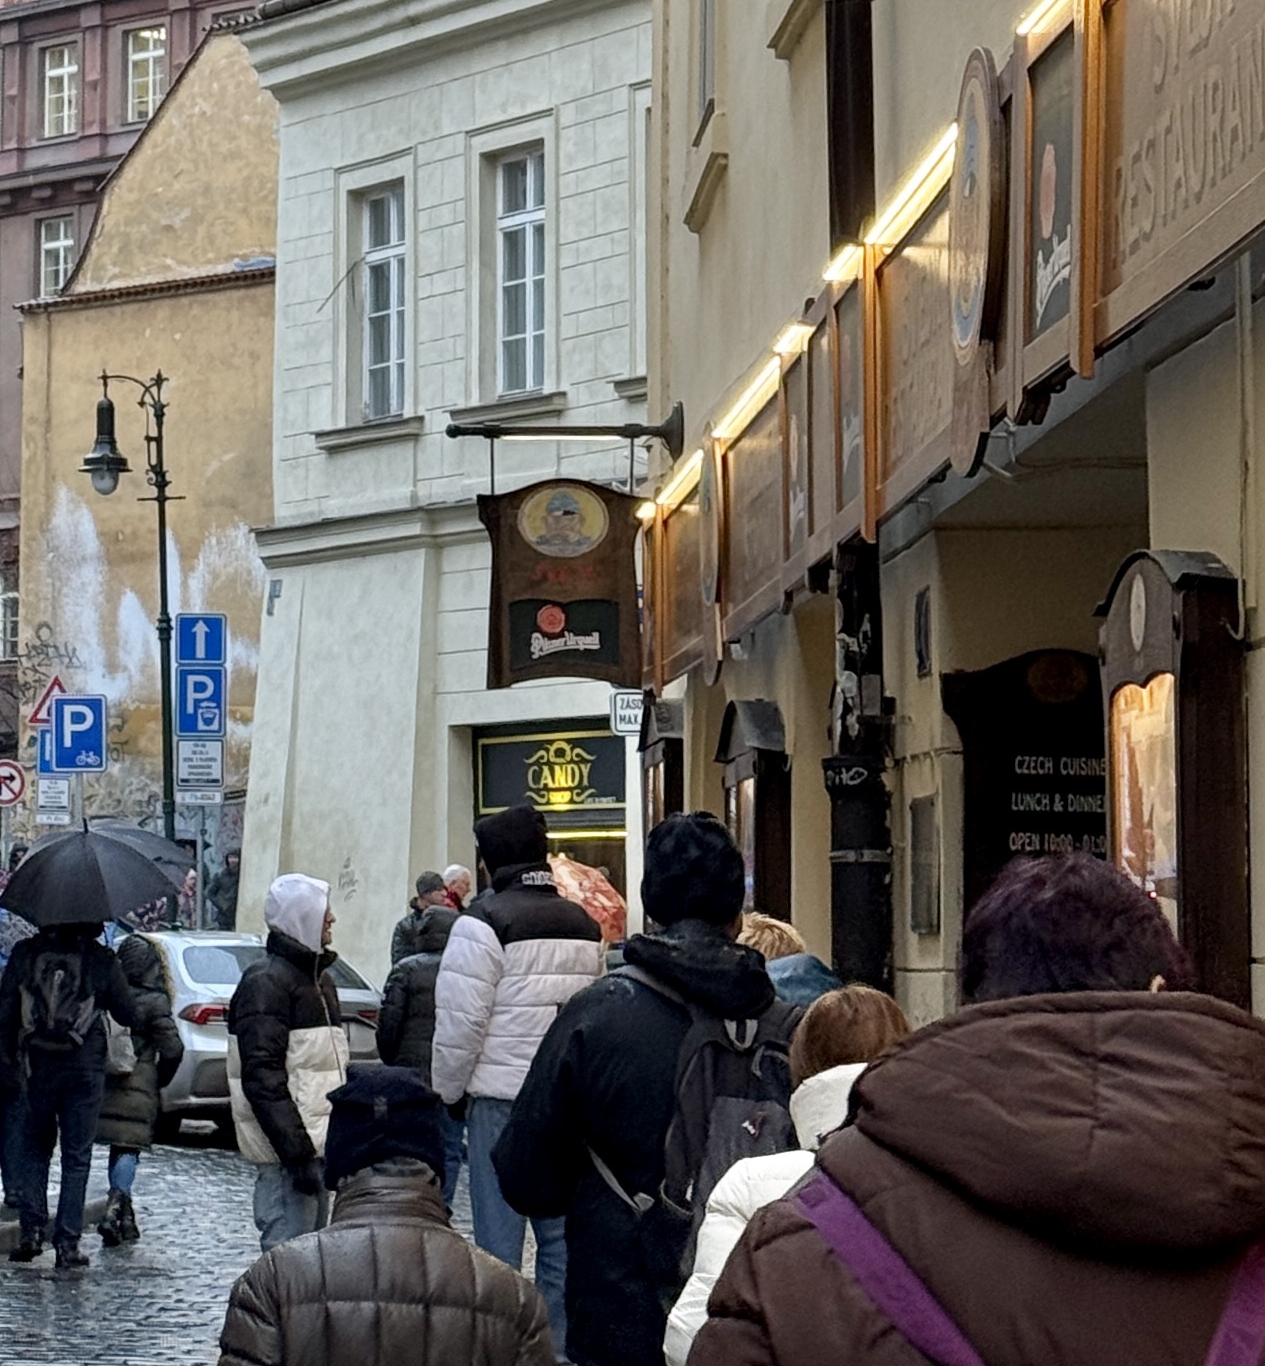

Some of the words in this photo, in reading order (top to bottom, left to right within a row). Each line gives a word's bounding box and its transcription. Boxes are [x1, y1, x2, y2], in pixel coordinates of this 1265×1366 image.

[186, 674, 214, 714] P
[63, 705, 94, 748] P
[1015, 755, 1053, 774] CZECH
[527, 763, 592, 788] CANDY
[549, 790, 571, 803] SHOP
[1011, 792, 1050, 811] LUNCH
[1053, 793, 1065, 812] &
[1067, 793, 1106, 812] DINNE
[1009, 832, 1040, 851] OPEN
